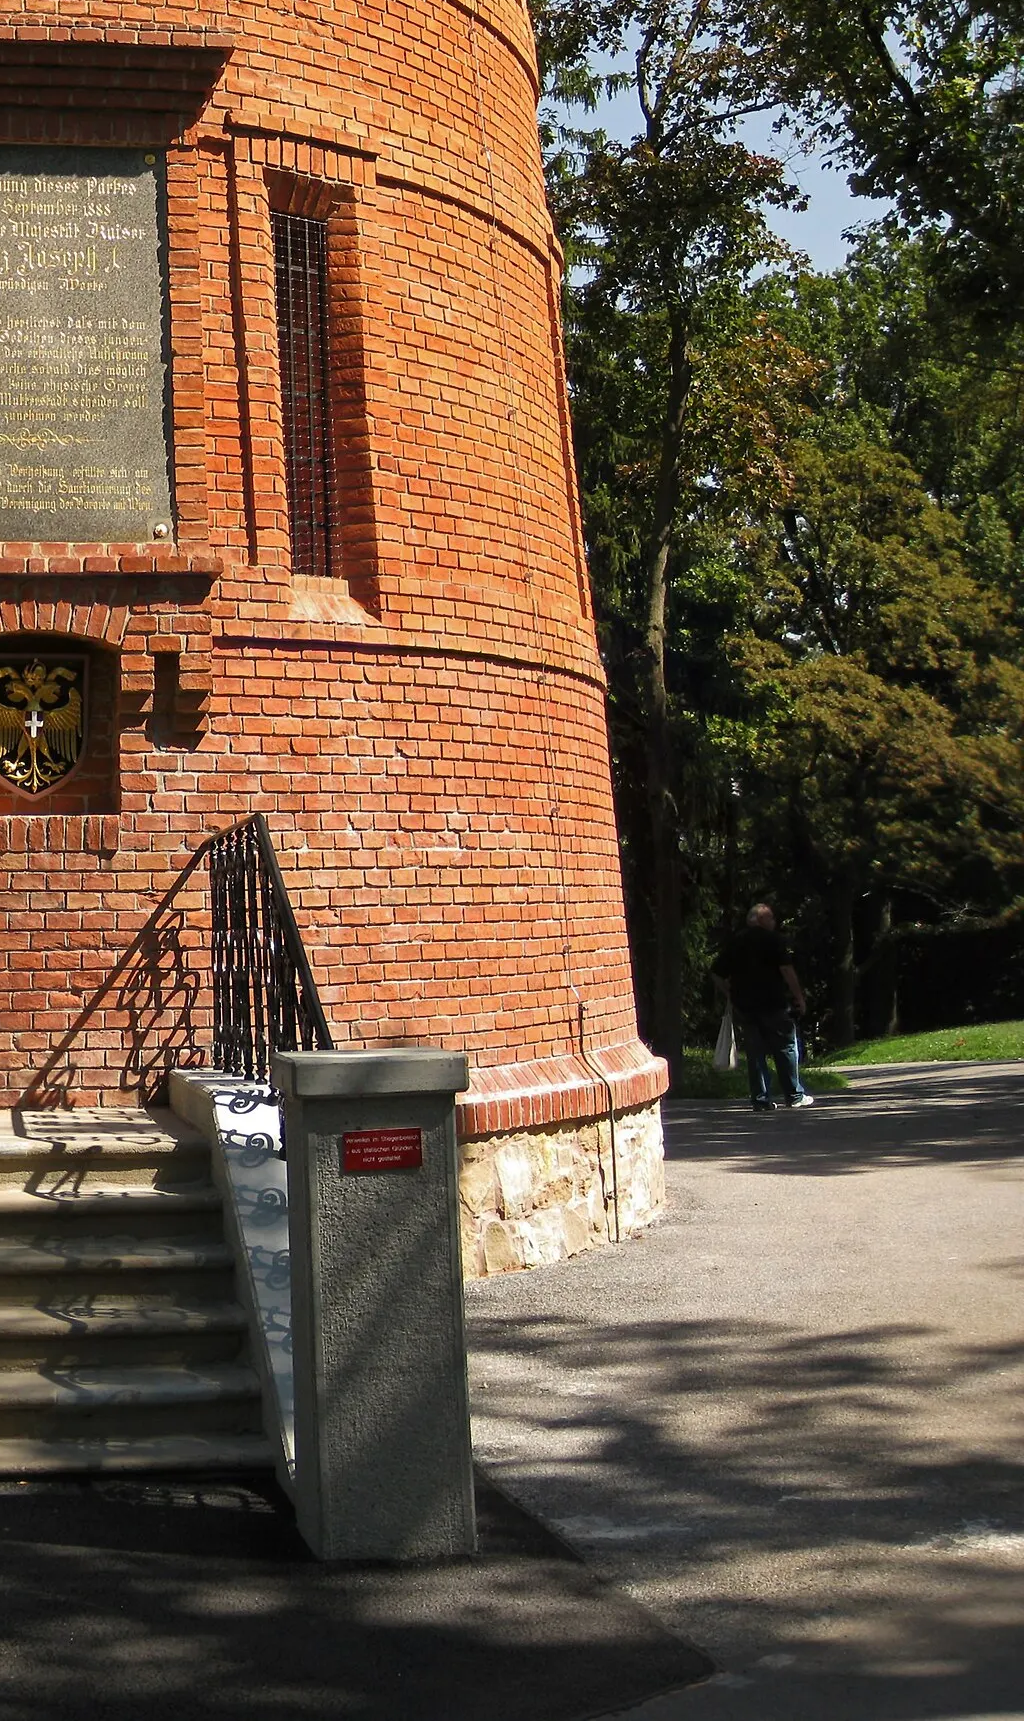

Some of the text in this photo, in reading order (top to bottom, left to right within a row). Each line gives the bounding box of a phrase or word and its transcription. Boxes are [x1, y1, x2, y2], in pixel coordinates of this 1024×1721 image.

[34, 177, 79, 194] dieses
[86, 176, 137, 198] Parkes
[82, 201, 112, 218] 1888
[8, 218, 80, 242] Majestät
[86, 220, 147, 241] Kaiser
[16, 240, 98, 276] Joseph
[98, 317, 118, 330] mit
[121, 317, 146, 330] dem
[59, 331, 97, 345] dieses
[4, 345, 23, 359] der
[31, 362, 71, 376] sobald
[77, 362, 102, 376] dies
[105, 362, 147, 379] möglich
[71, 394, 119, 408] scheiden
[4, 409, 57, 424] zunehmen
[109, 466, 128, 479] sich
[6, 479, 33, 493] durch
[38, 480, 52, 494] die
[135, 481, 152, 495] des
